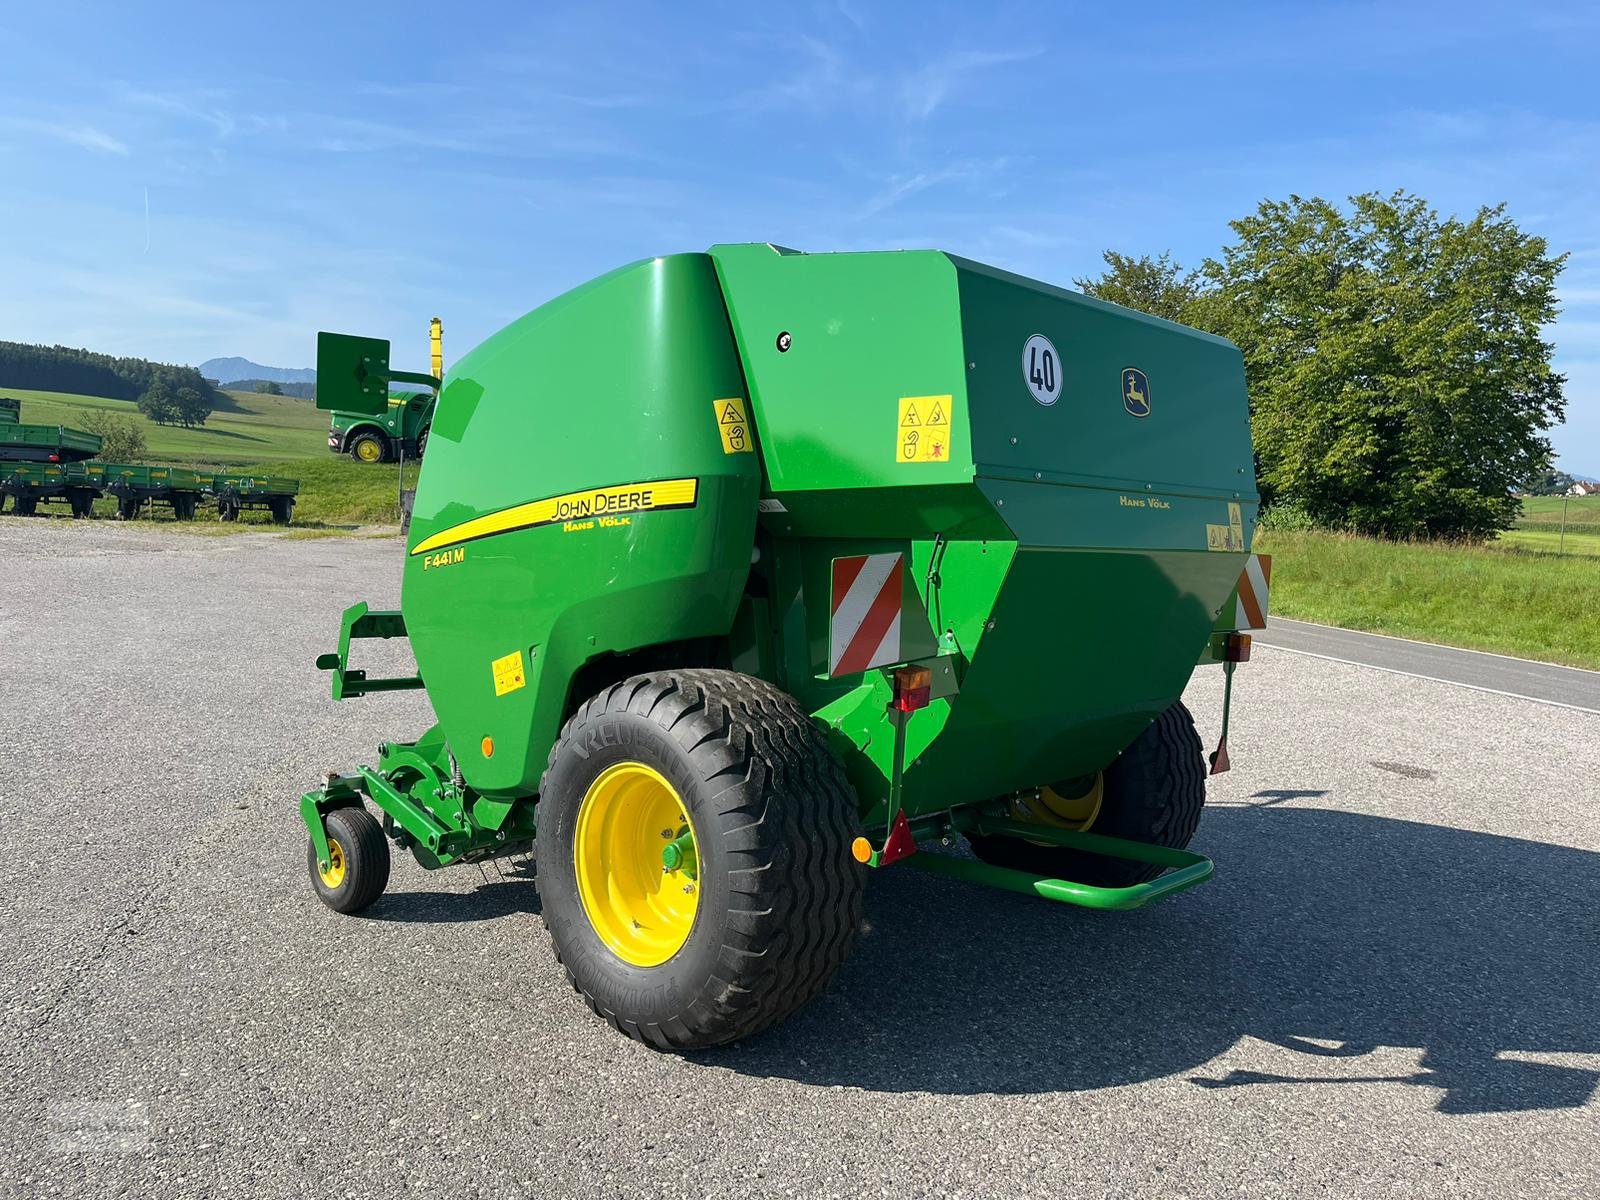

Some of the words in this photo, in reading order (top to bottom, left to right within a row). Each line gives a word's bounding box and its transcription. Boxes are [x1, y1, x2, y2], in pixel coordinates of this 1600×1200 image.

[1030, 347, 1055, 392] 40
[552, 499, 591, 519] JOHN
[595, 491, 653, 512] DEERE
[1119, 495, 1145, 508] HANS
[563, 521, 594, 533] HANS
[598, 516, 631, 528] VÖLK
